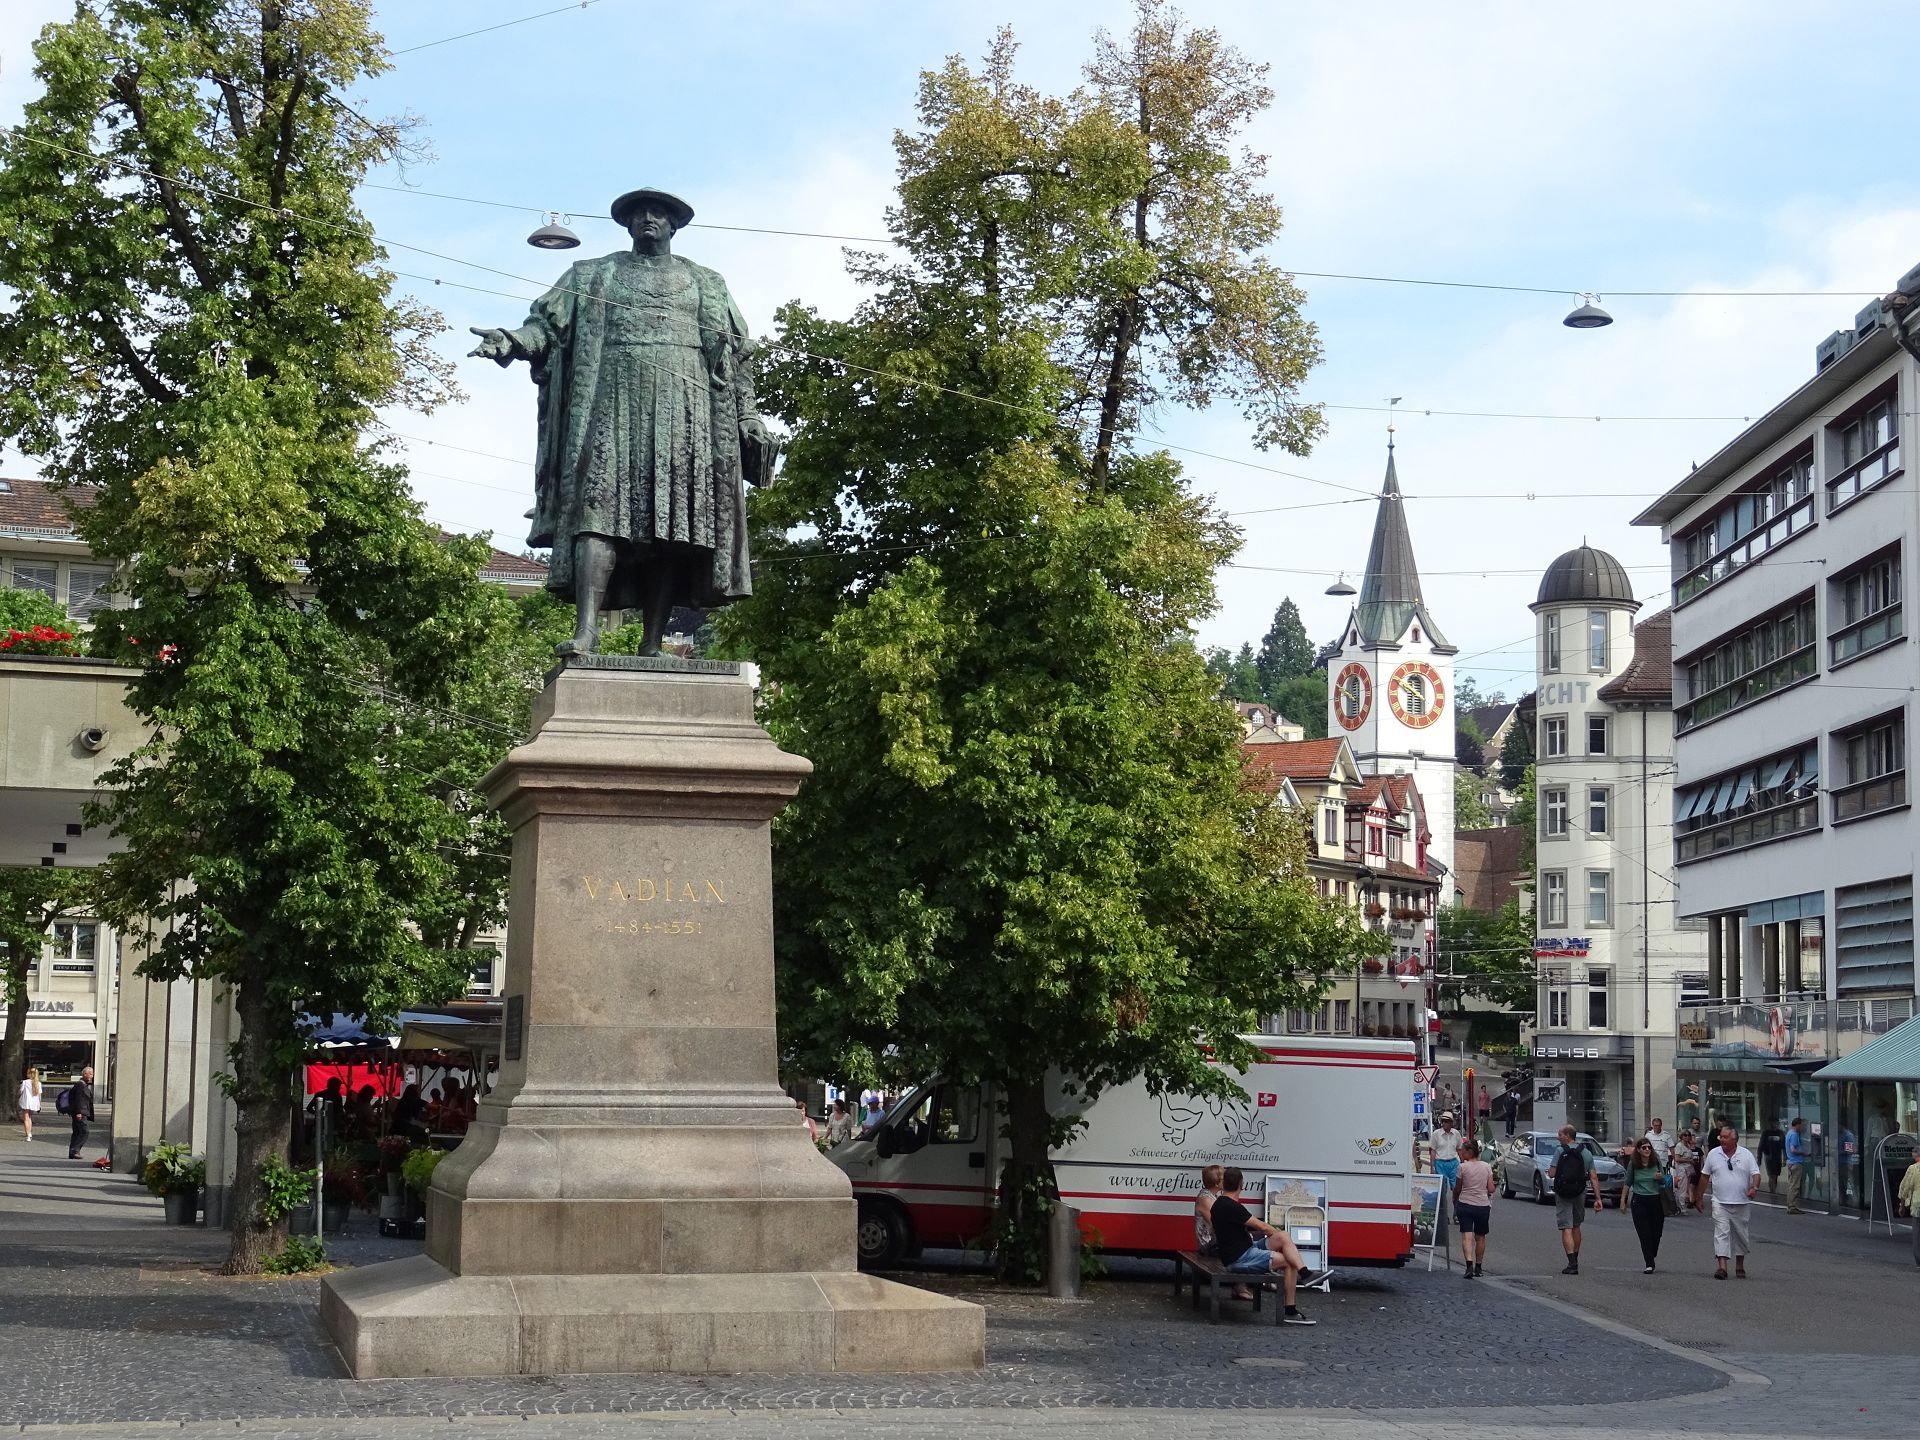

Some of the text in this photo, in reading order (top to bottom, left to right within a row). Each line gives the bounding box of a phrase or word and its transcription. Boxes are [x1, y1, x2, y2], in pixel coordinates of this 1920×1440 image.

[582, 875, 729, 903] VADIAN
[29, 1000, 74, 1012] JEANS
[1533, 1047, 1599, 1058] 123456
[1129, 1147, 1280, 1163] Schweizer Geflügelspezialitäten
